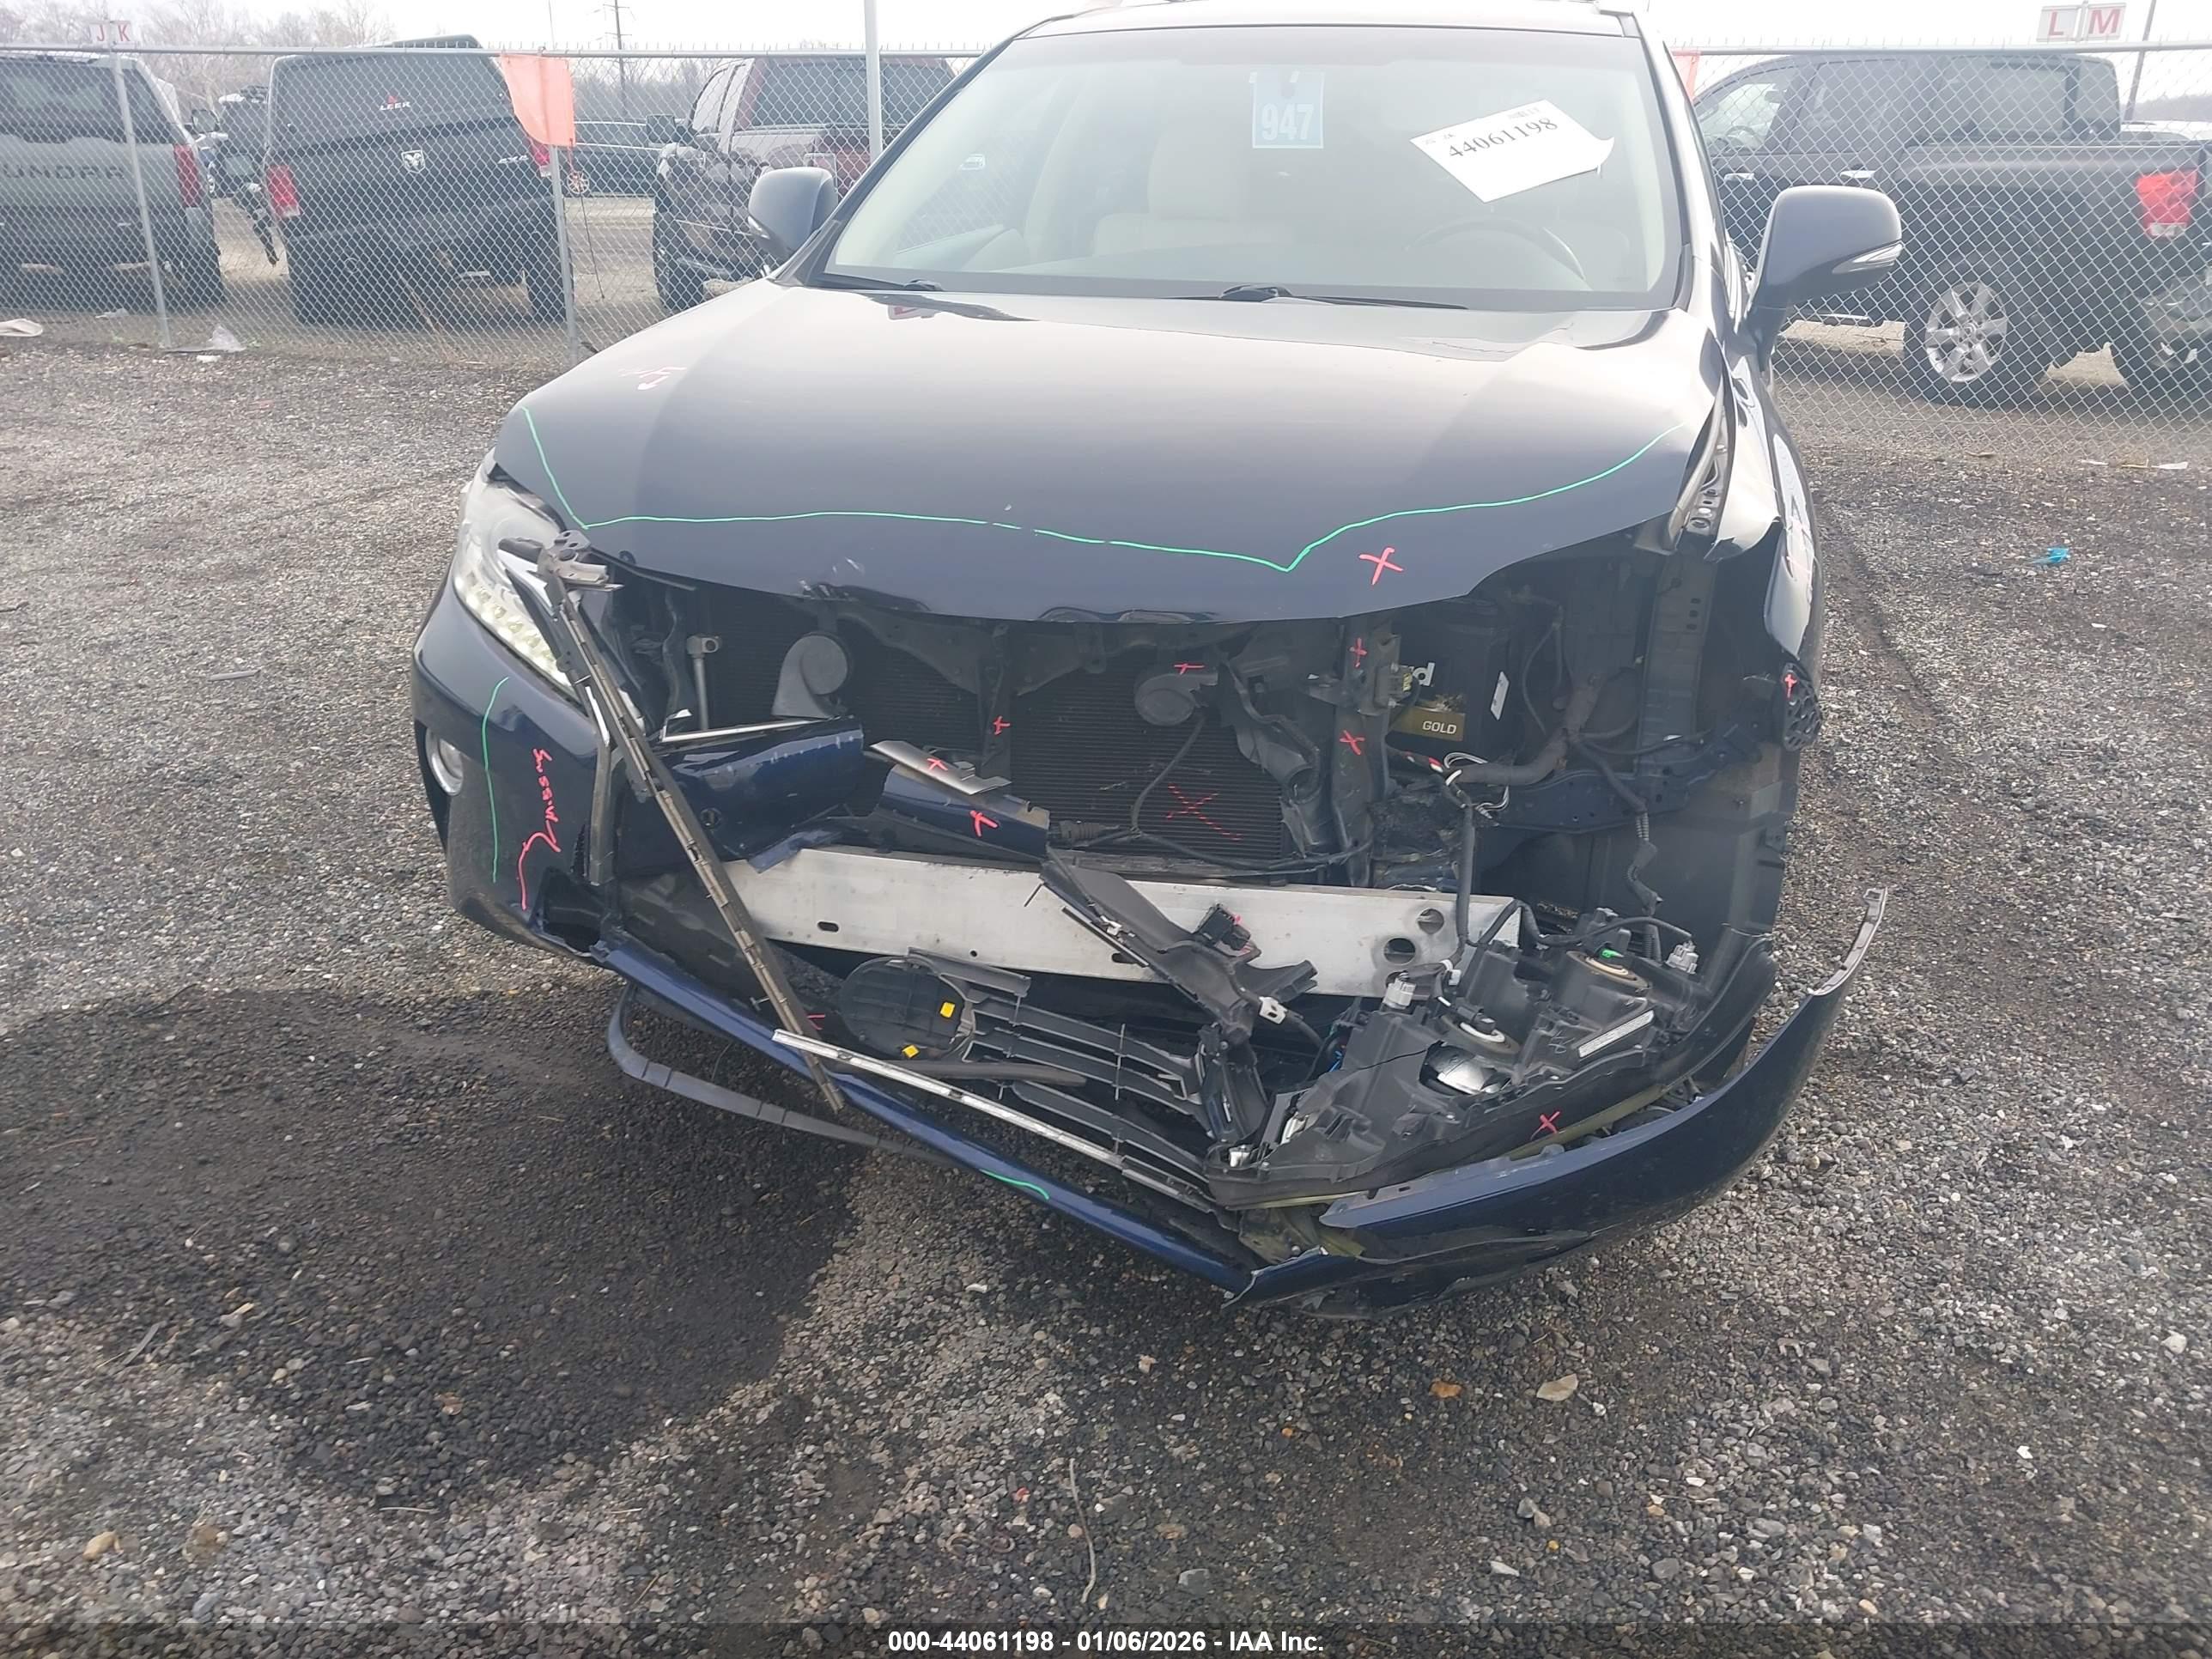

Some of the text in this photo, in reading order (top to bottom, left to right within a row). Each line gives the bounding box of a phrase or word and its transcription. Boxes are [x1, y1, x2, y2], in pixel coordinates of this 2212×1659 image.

[96, 24, 131, 42] J K
[2048, 9, 2121, 36] L M
[1262, 102, 1314, 141] 947
[1449, 117, 1558, 157] 44061198
[1422, 720, 1457, 734] GOLD
